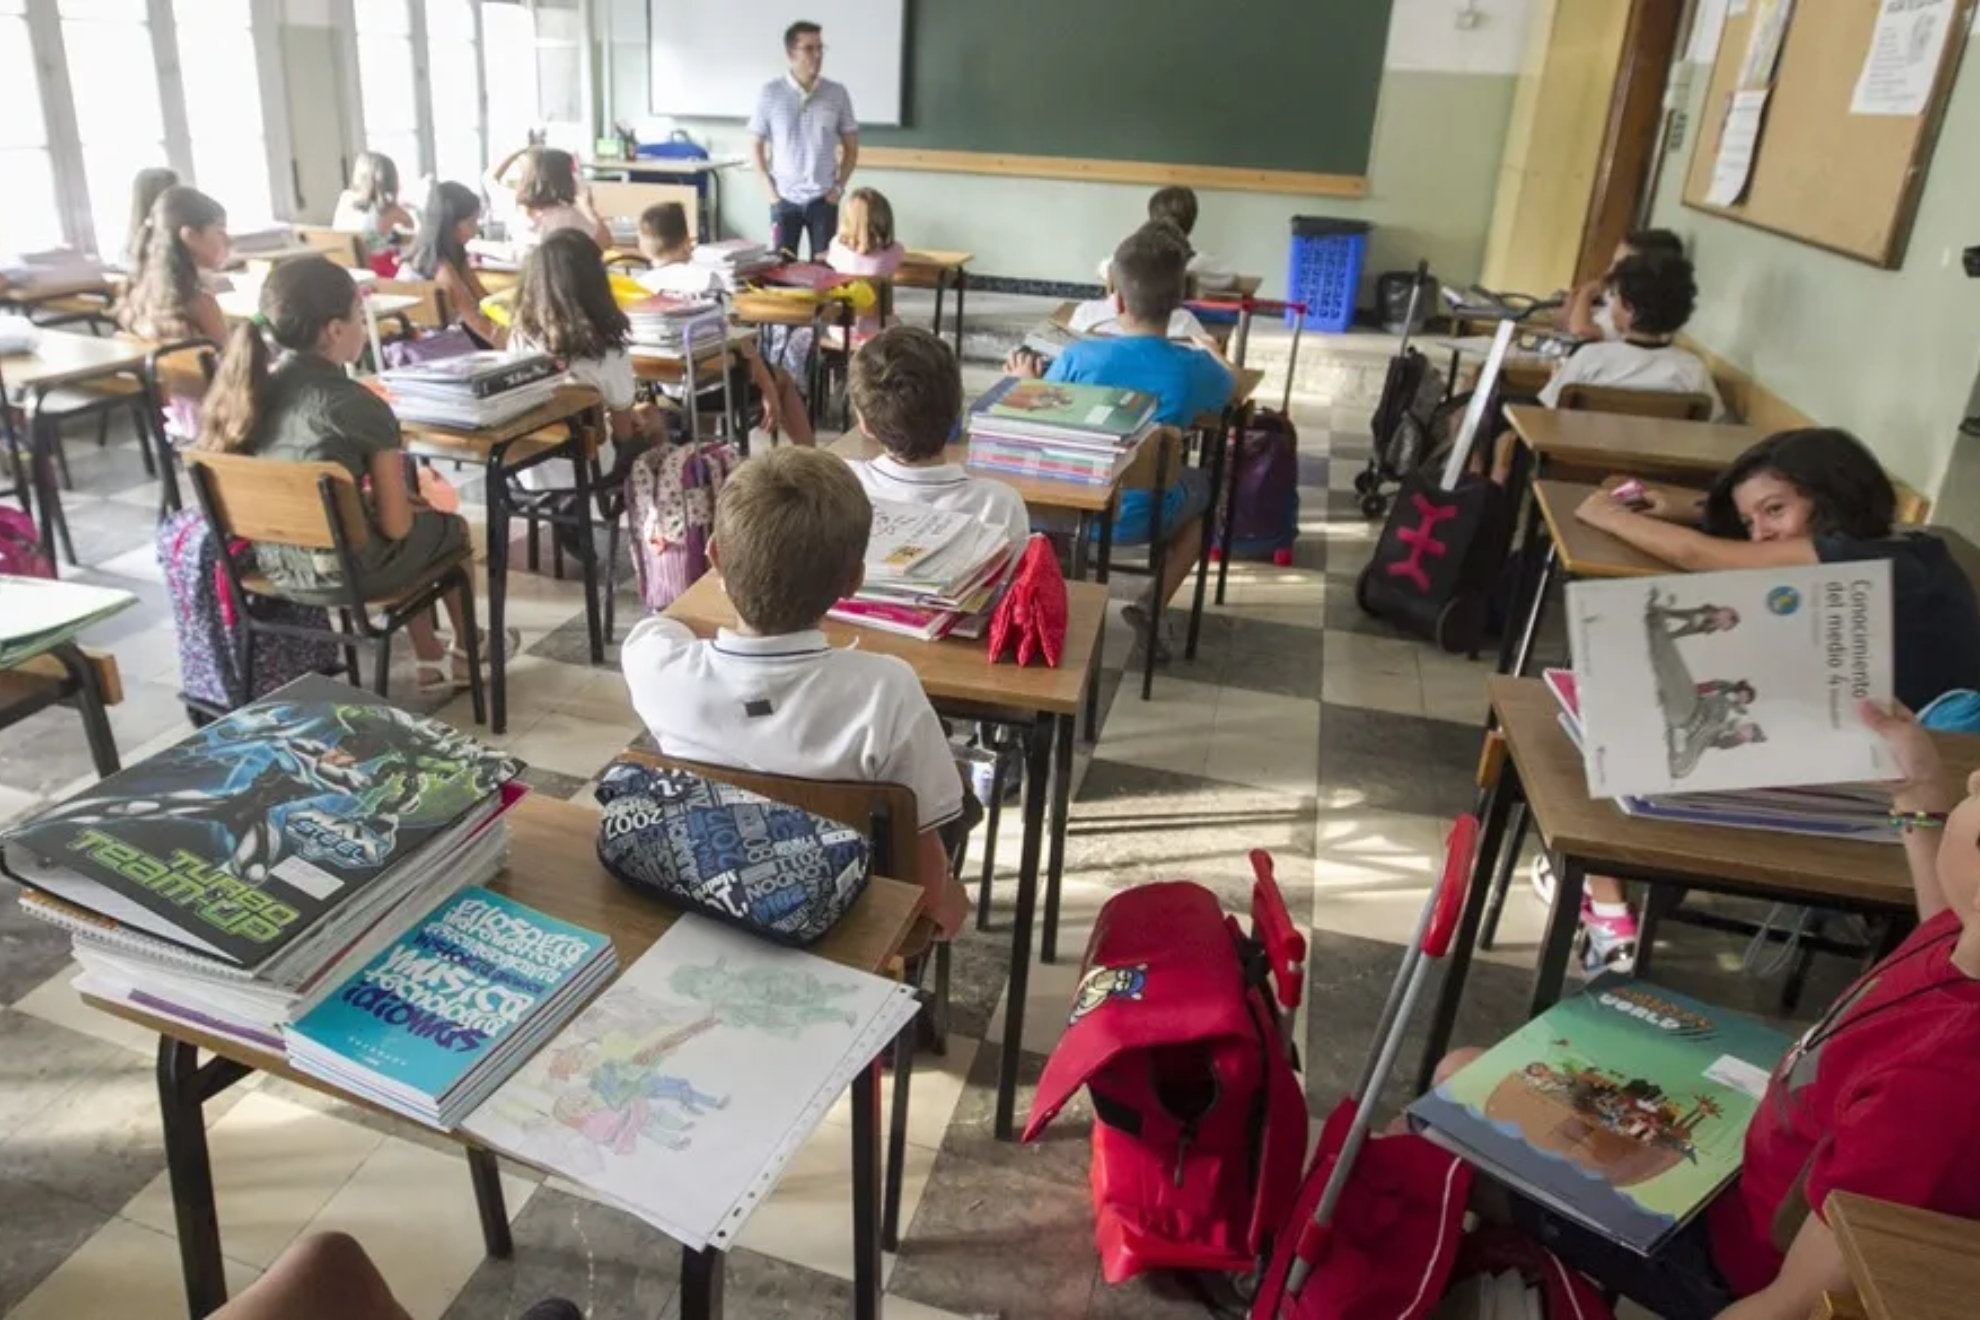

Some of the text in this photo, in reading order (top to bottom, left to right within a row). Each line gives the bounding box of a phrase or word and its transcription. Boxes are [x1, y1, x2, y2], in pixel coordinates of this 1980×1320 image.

[1825, 581, 1846, 607] del
[1826, 614, 1846, 668] medio
[1851, 579, 1872, 698] Conocimiento
[1827, 674, 1850, 685] 4
[169, 848, 299, 928] TURBO
[744, 857, 832, 902] LONDON
[1599, 992, 1681, 1030] WORLD
